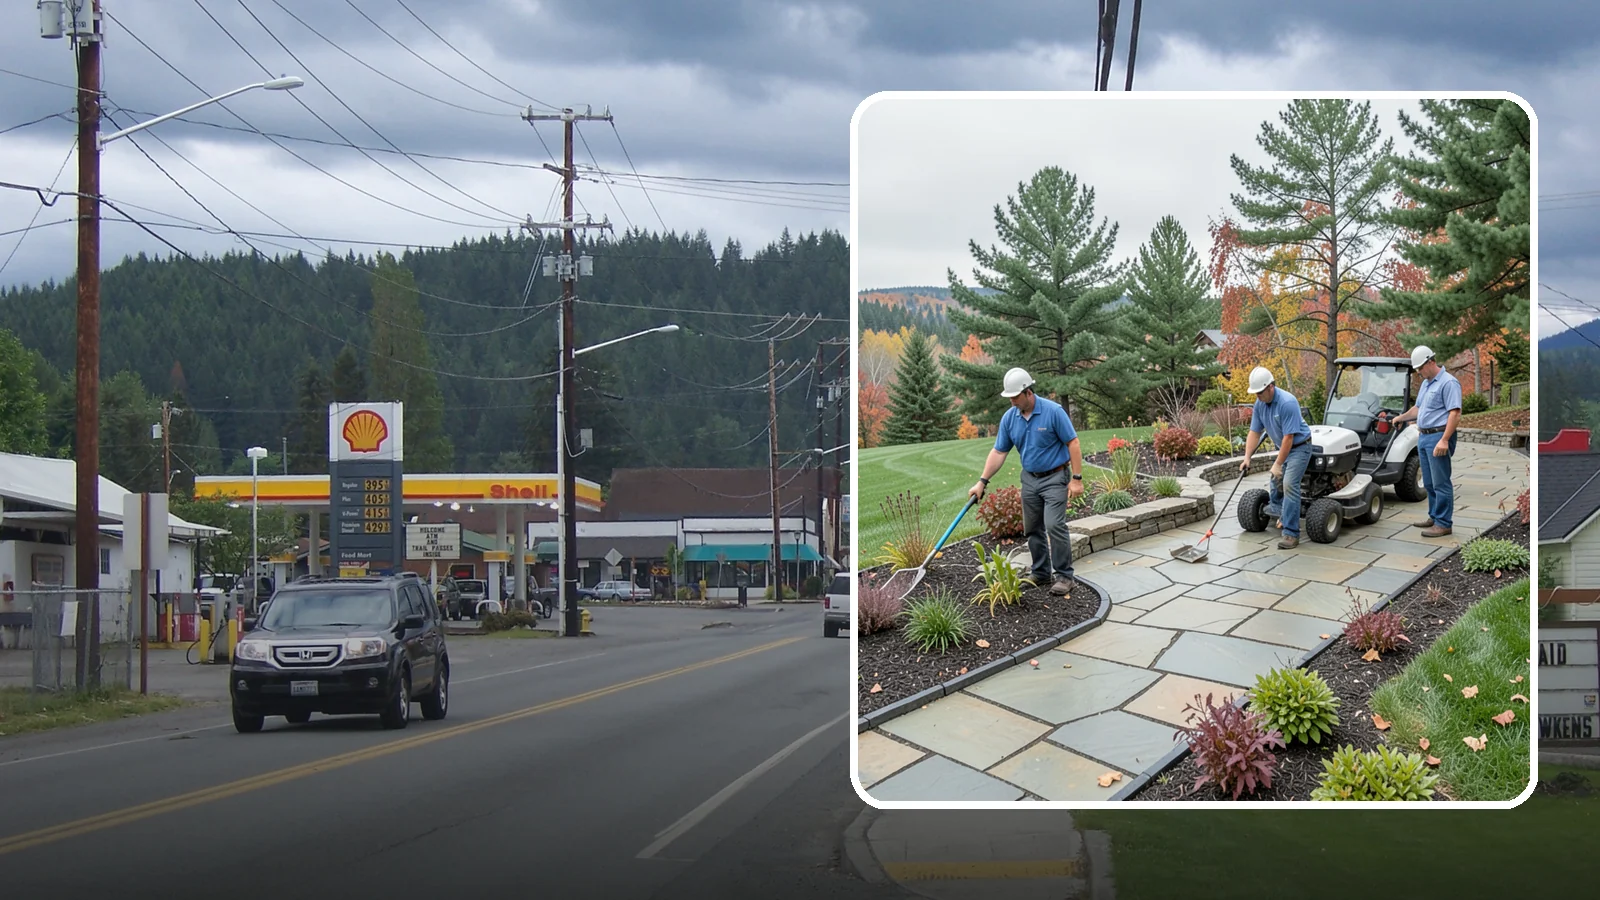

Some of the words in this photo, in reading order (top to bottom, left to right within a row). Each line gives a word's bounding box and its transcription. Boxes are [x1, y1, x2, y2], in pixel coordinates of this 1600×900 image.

[365, 480, 383, 490] 395
[490, 484, 547, 499] Shell
[365, 494, 383, 504] 405
[365, 508, 383, 518] 415
[365, 522, 383, 533] 429
